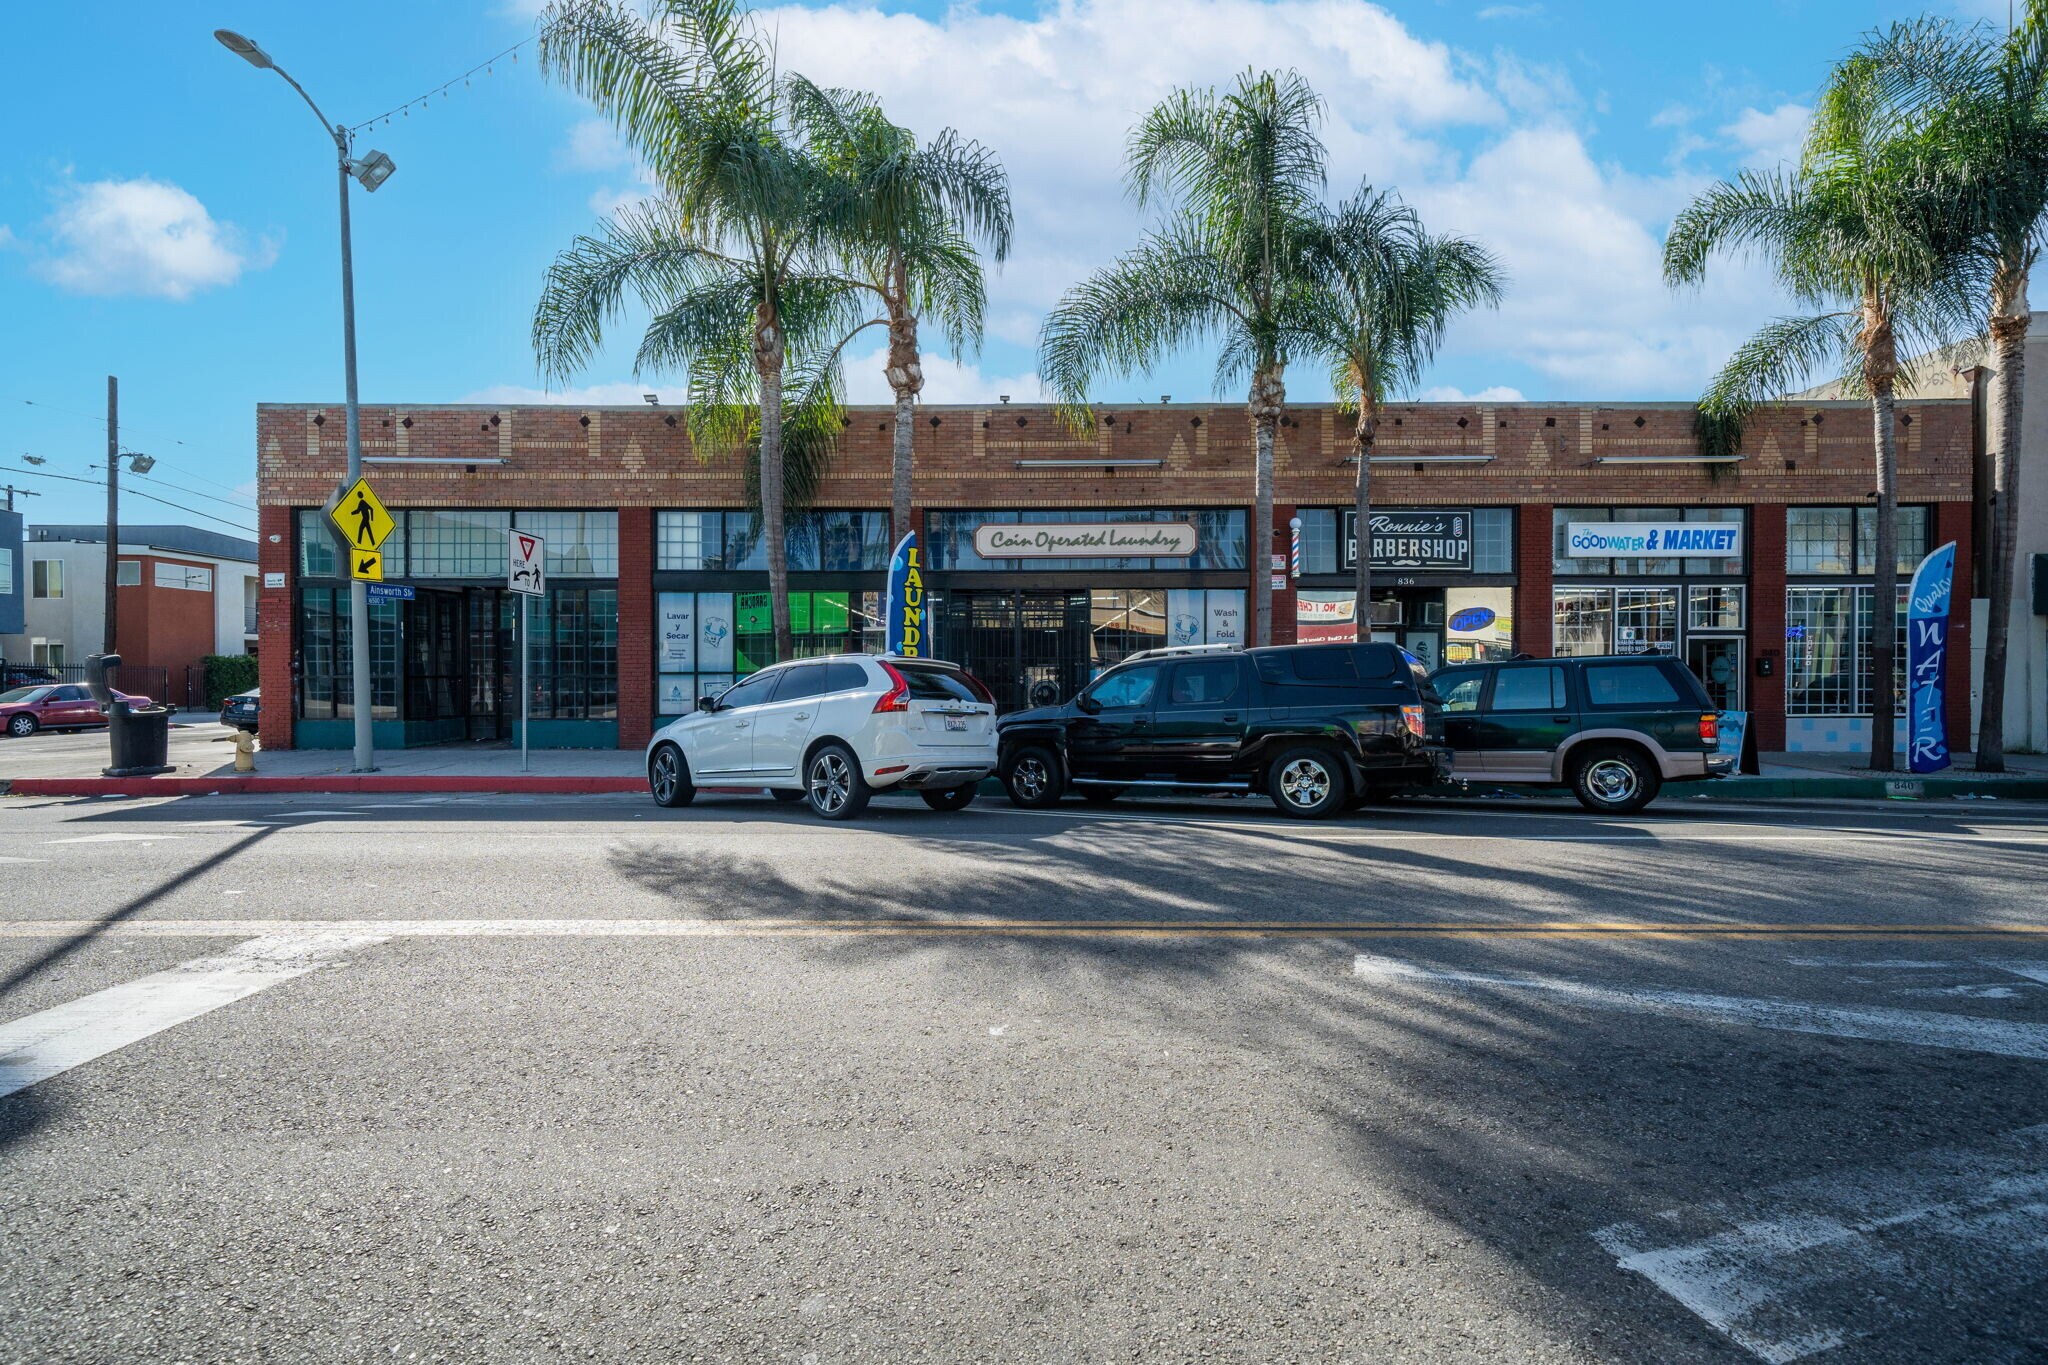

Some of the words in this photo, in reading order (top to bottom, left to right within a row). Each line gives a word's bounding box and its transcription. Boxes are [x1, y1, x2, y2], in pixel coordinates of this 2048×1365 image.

[1368, 515, 1447, 533] Ronnie's
[990, 530, 1033, 548] Coin
[1035, 530, 1106, 551] Operated
[1109, 529, 1181, 552] Laundry
[1646, 529, 1659, 551] &
[1663, 529, 1737, 550] MARKET
[1348, 538, 1468, 561] BRBERSHOP
[512, 559, 526, 569] HERE
[524, 578, 531, 587] TO
[1397, 577, 1415, 585] 836
[370, 585, 402, 596] Ainsworth
[403, 588, 410, 597] St
[666, 612, 689, 620] Lavar
[1213, 609, 1238, 617] Wash
[1452, 608, 1489, 630] OPEN
[666, 632, 690, 640] Secar
[1216, 630, 1236, 638] Fold
[1911, 620, 1944, 763] WATER
[1894, 781, 1914, 791] 840
